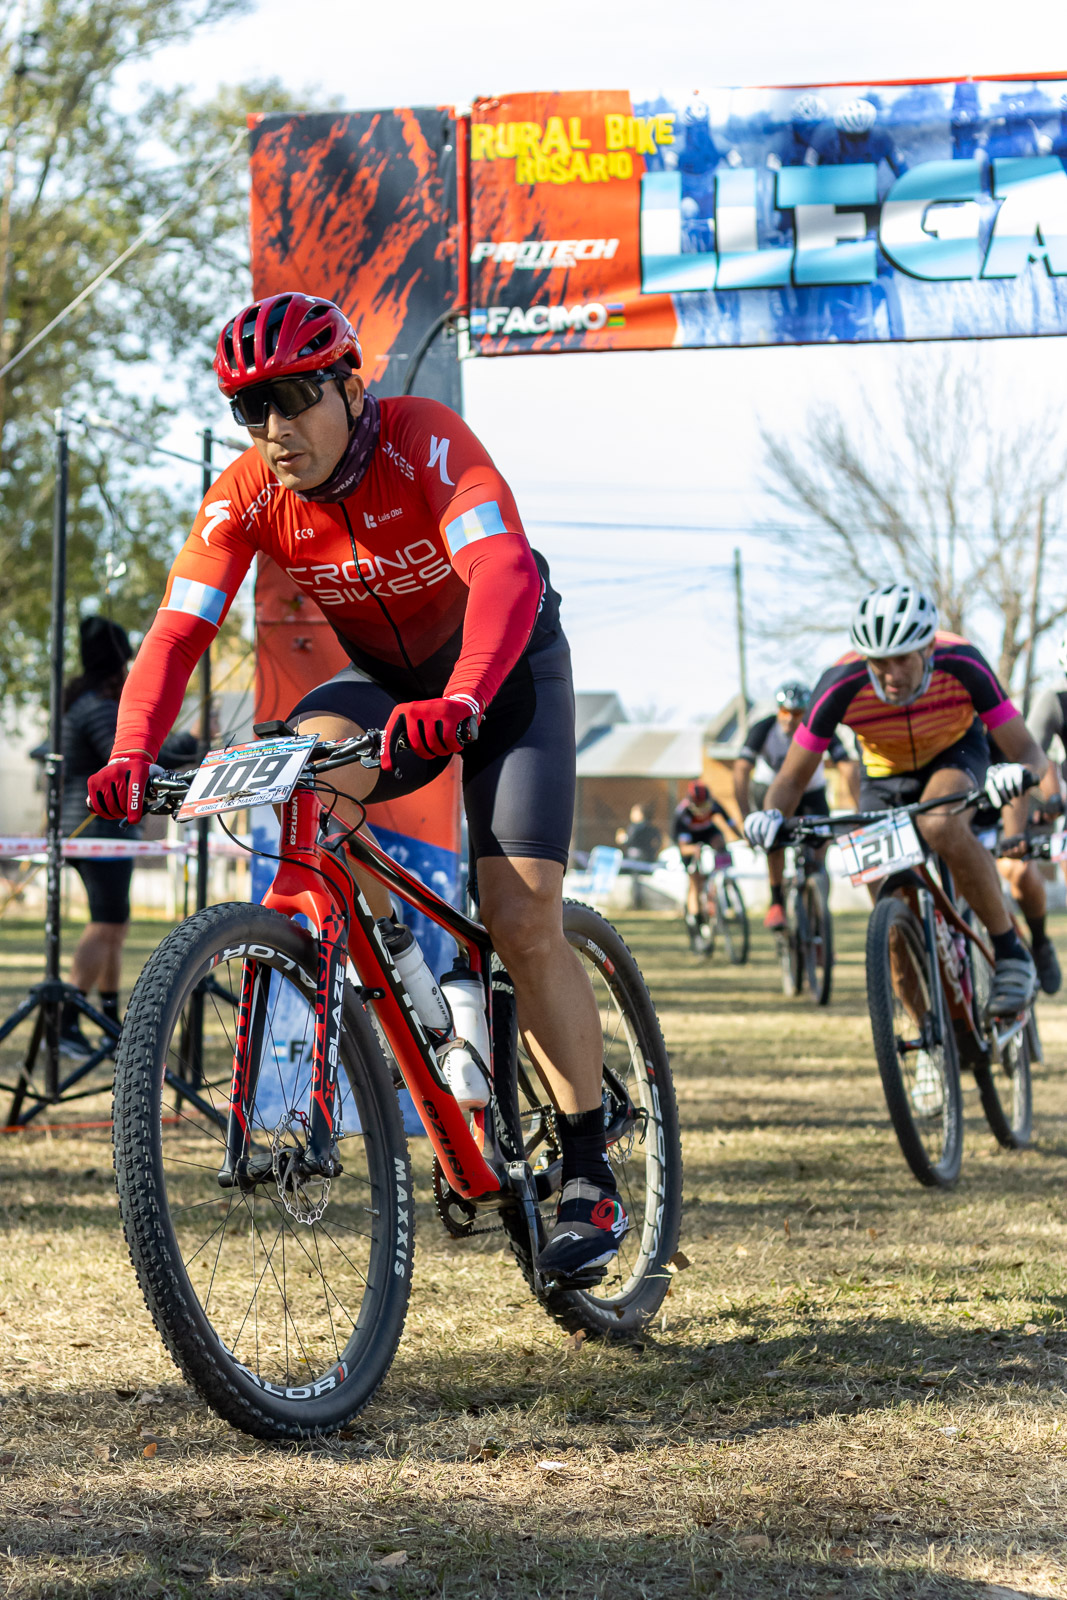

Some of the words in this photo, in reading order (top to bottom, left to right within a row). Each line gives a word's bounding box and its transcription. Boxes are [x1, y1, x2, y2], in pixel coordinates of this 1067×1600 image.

[471, 116, 591, 161] RURAL
[605, 113, 675, 155] BIKE
[516, 151, 633, 184] ROSARIO
[470, 239, 619, 263] PROTECH
[487, 302, 608, 335] FACIMO
[286, 539, 437, 586] CRONO
[313, 557, 452, 606] BIKES
[131, 782, 140, 811] GIYO
[199, 753, 293, 799] 109
[861, 832, 895, 870] 21
[222, 944, 317, 989] ALOR
[393, 1157, 409, 1279] MAXXIS
